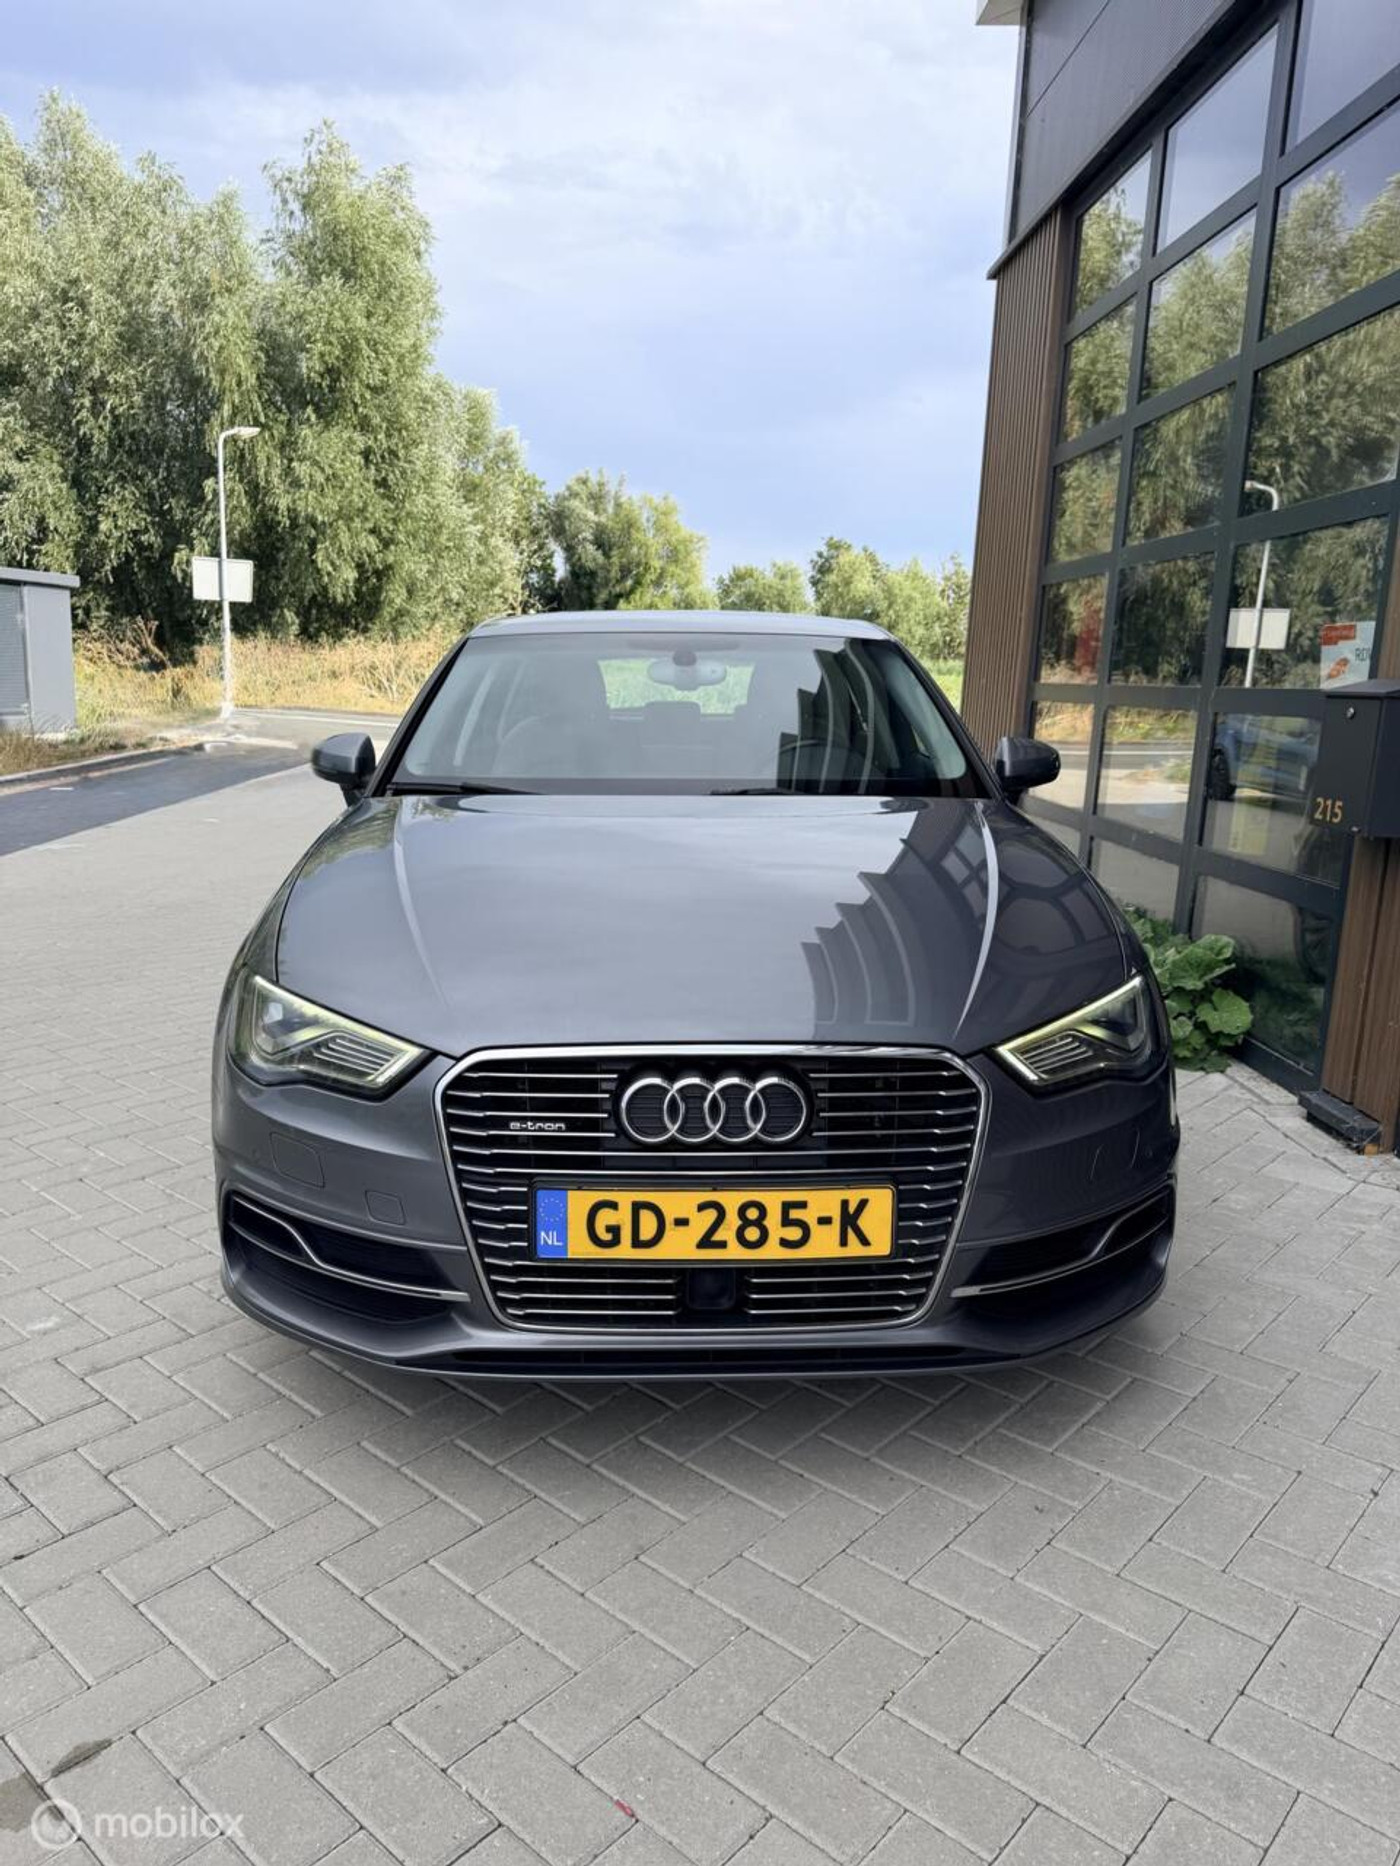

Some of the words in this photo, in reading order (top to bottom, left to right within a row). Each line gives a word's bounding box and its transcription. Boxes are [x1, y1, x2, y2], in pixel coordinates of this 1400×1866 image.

[1314, 797, 1343, 823] 215
[510, 1121, 566, 1131] e-tron
[585, 1198, 872, 1250] GD-285-K
[540, 1232, 563, 1247] NL
